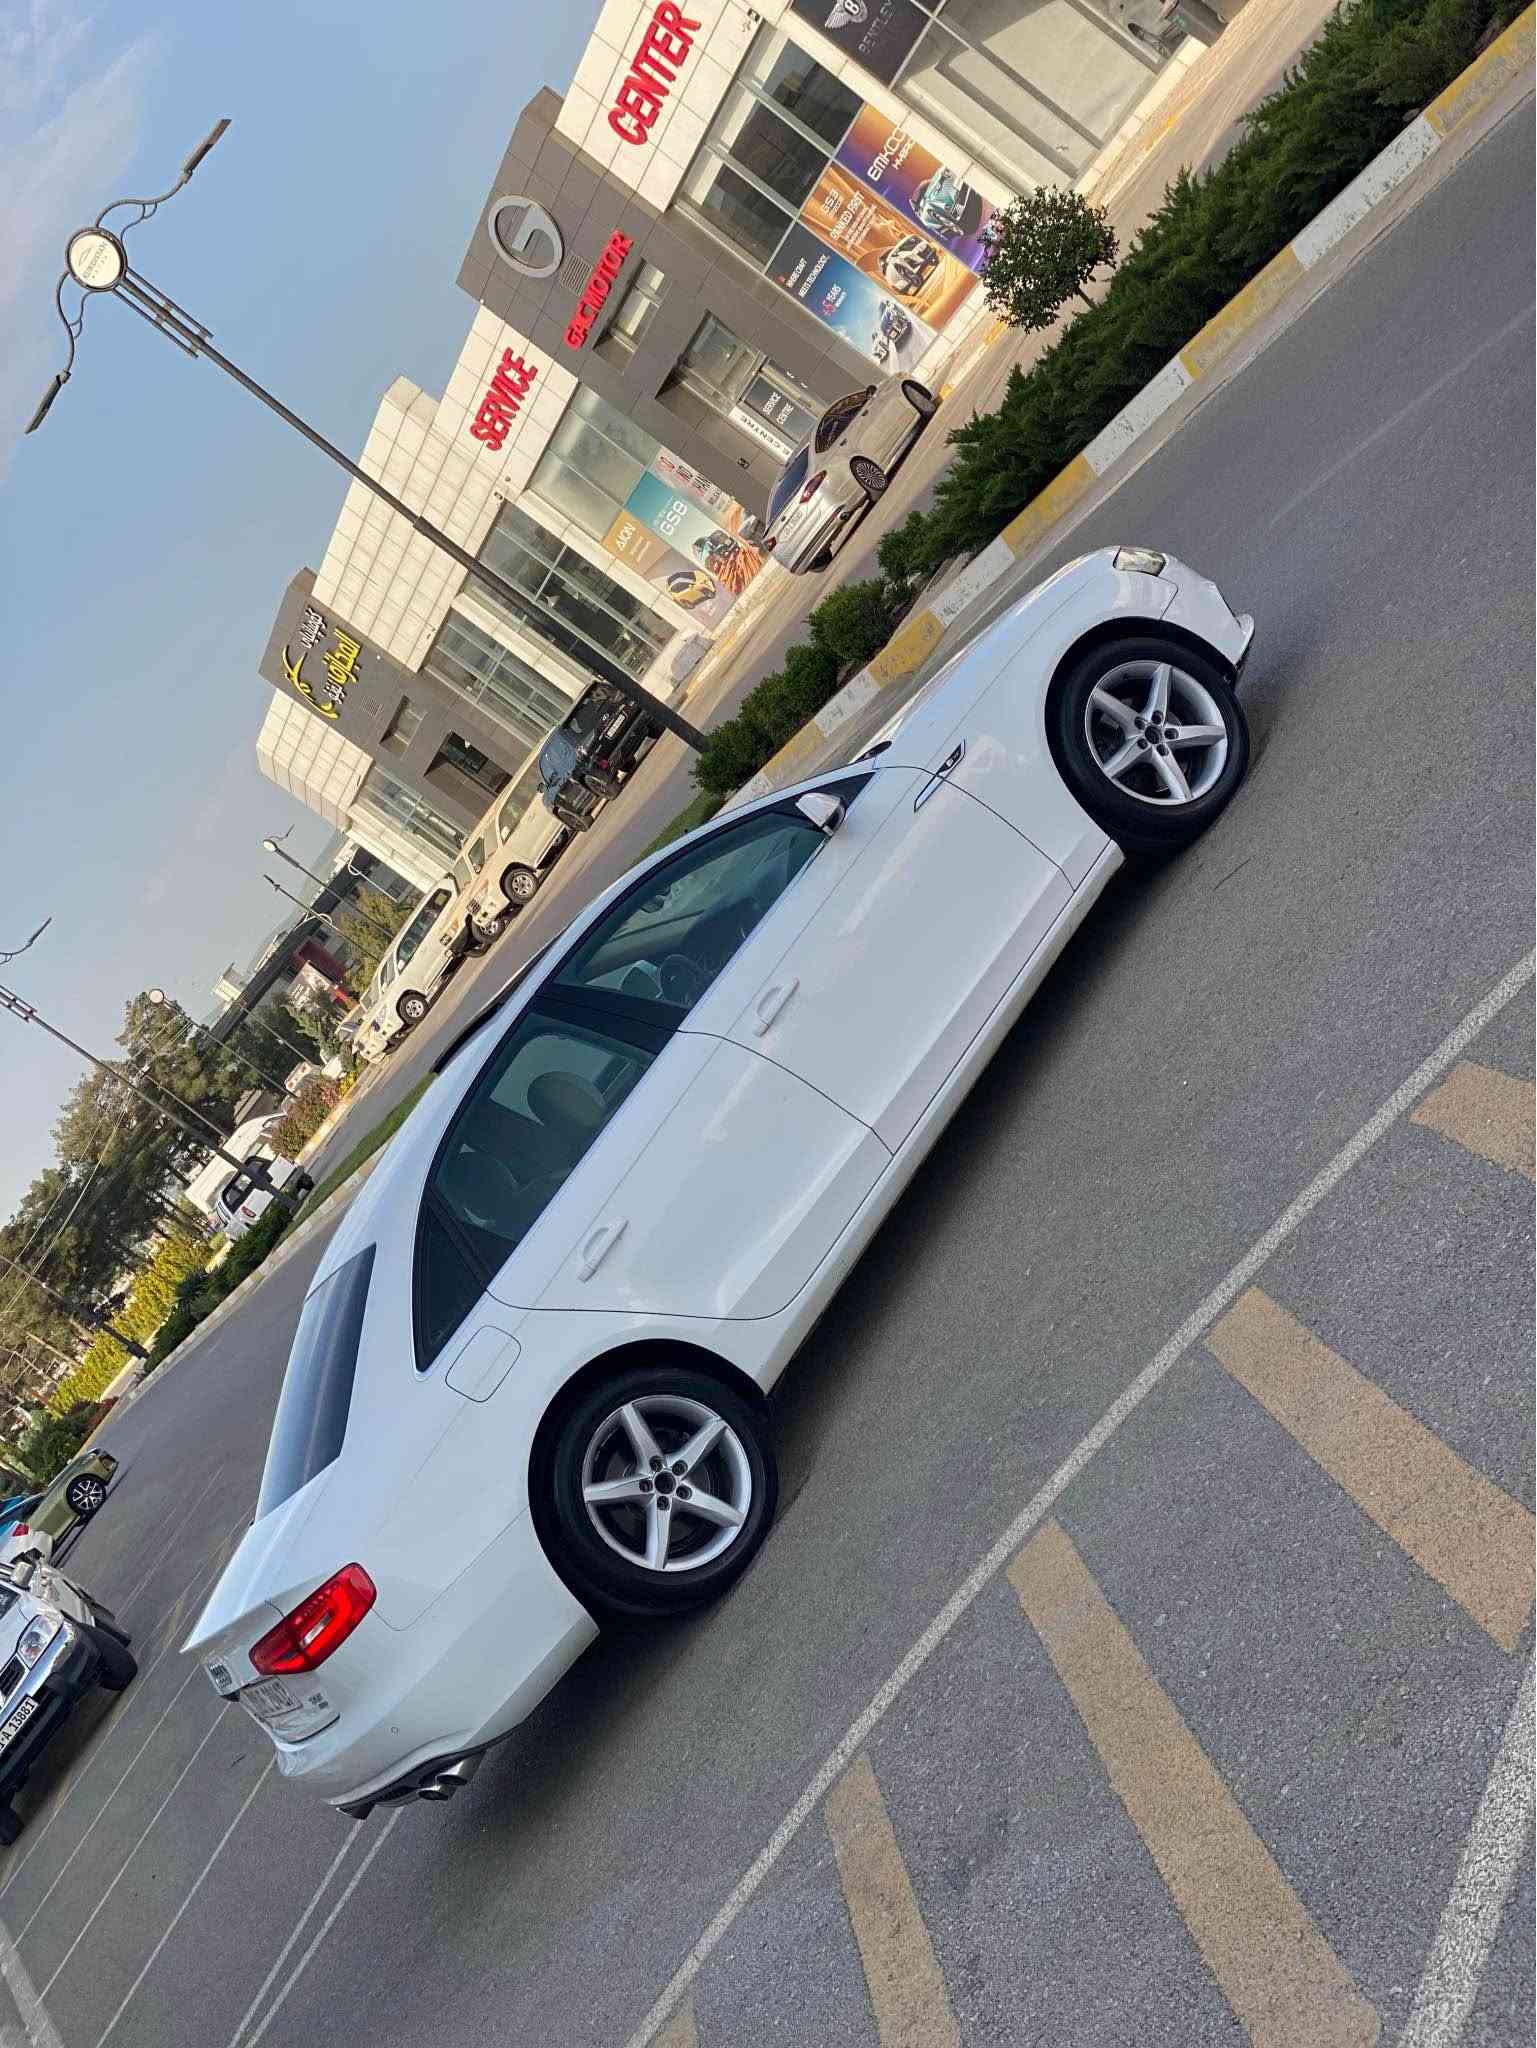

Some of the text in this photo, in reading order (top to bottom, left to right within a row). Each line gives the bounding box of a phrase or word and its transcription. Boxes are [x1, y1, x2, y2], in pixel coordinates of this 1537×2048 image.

[608, 1, 702, 145] CENTER
[469, 346, 538, 451] SERVICE
[660, 500, 688, 536] GS8
